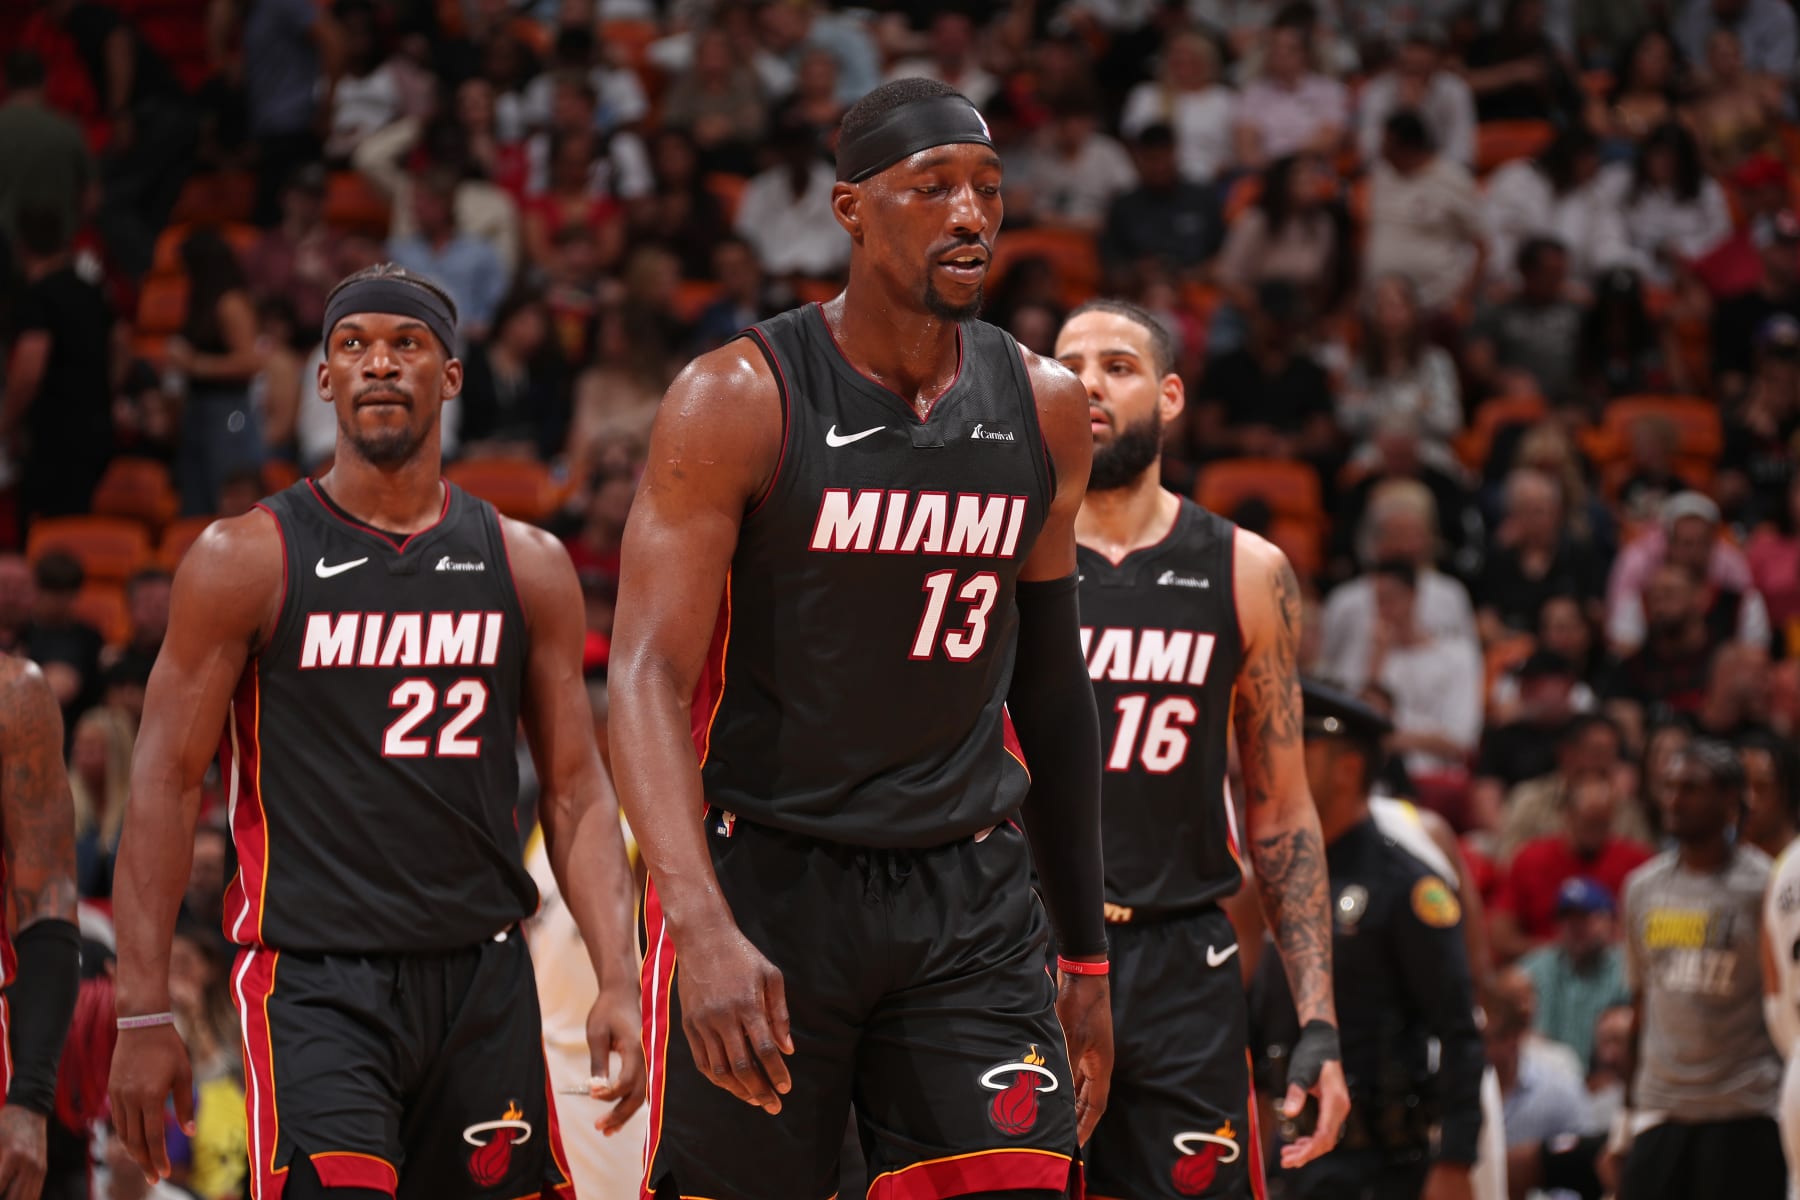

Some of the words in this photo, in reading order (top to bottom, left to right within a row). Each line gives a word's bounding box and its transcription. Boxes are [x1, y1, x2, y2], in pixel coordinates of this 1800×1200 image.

[808, 488, 1028, 559] MIAMI
[299, 611, 503, 669] MIAMI
[907, 569, 1001, 662] 13
[381, 677, 489, 758] 22
[1105, 693, 1200, 776] 16
